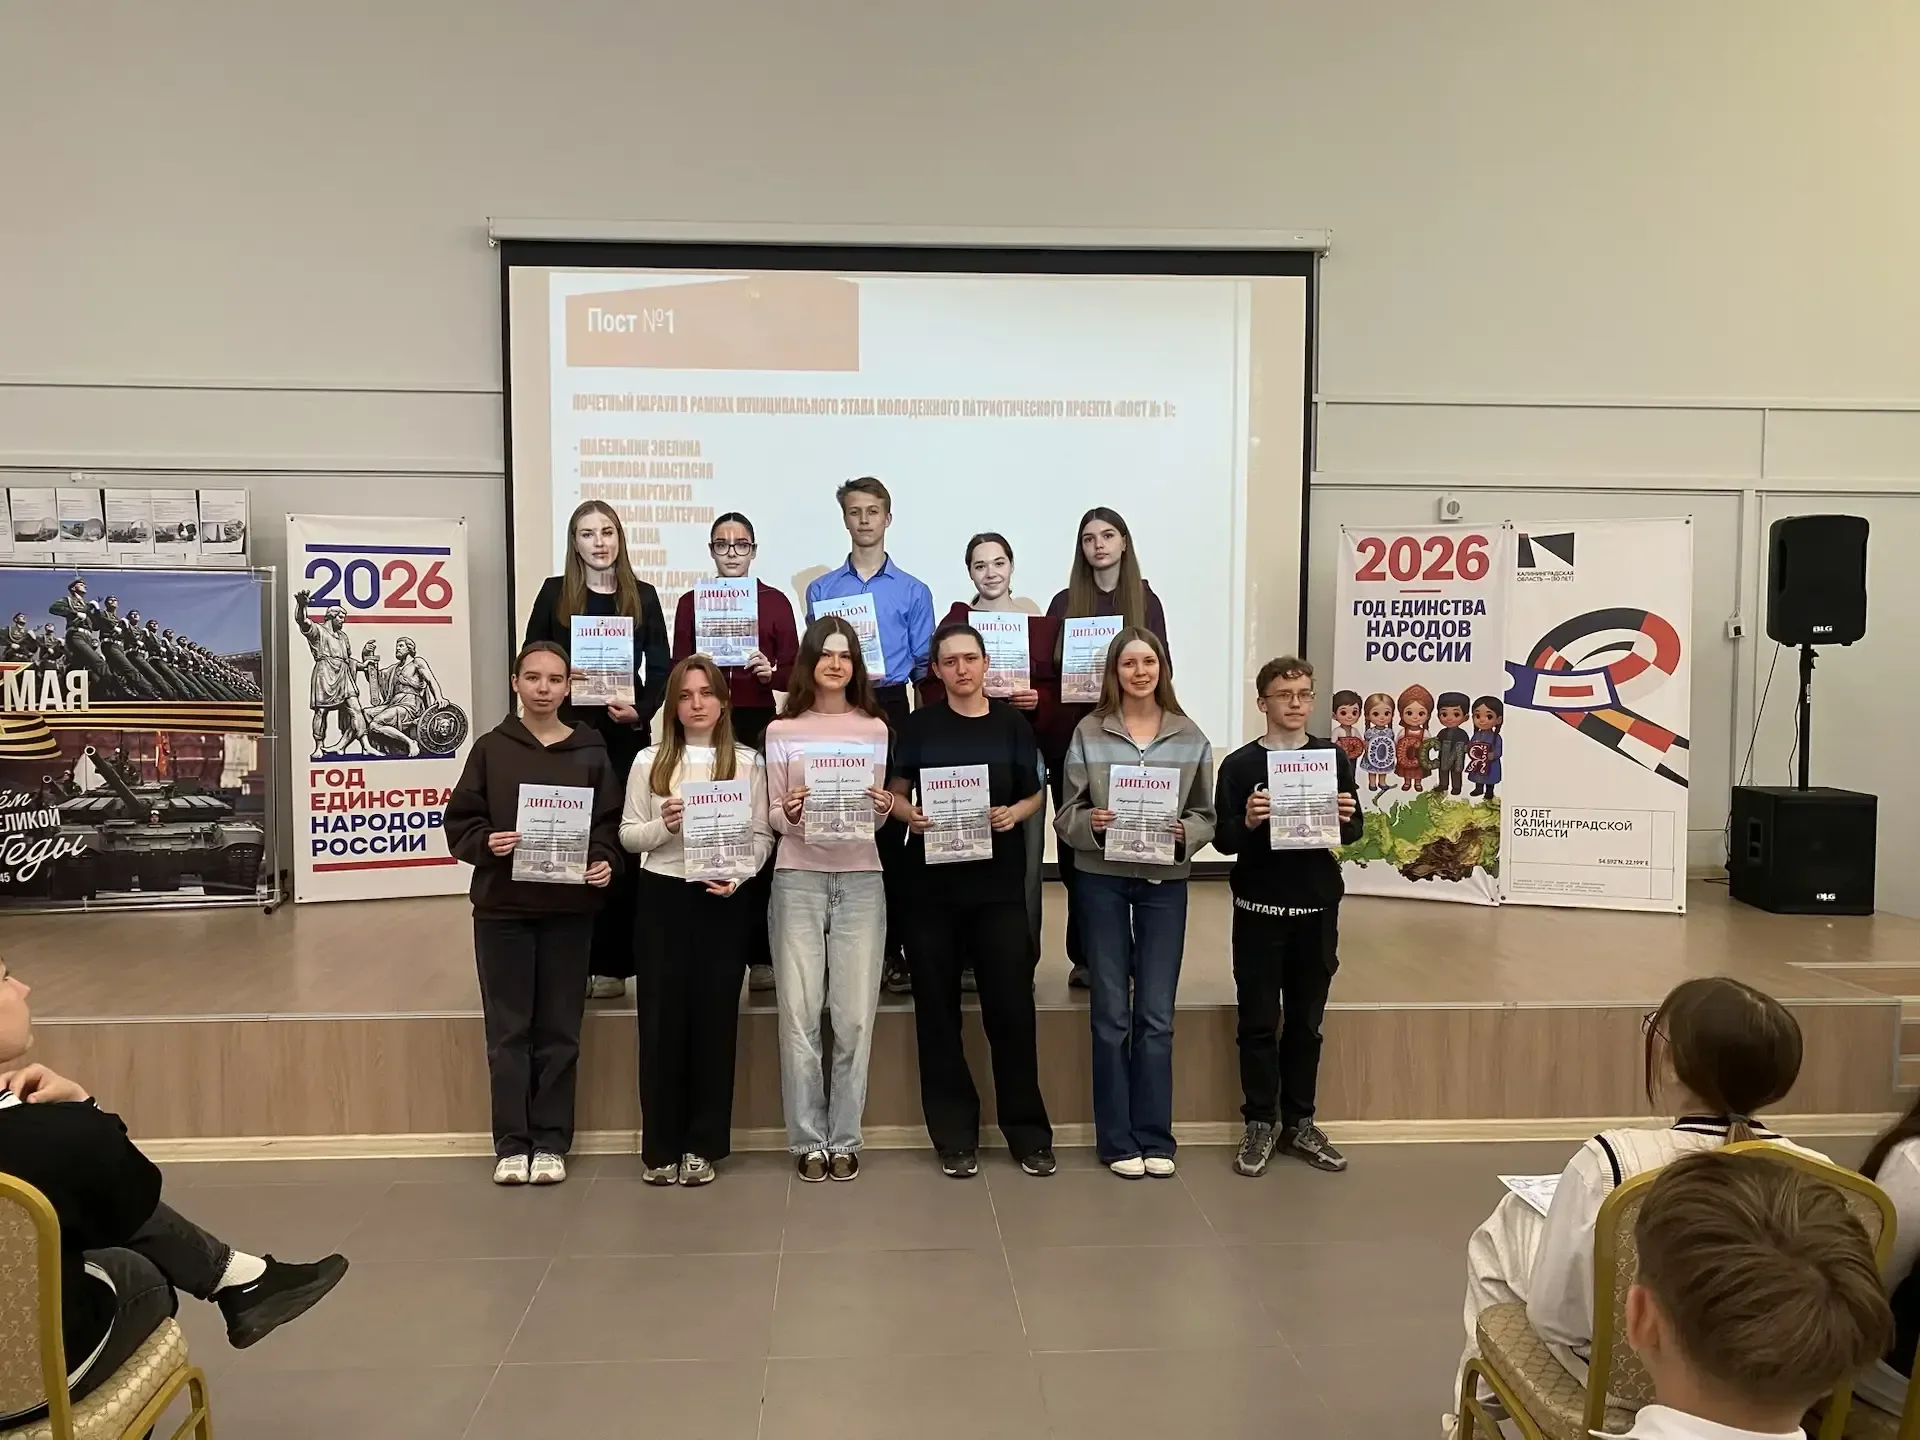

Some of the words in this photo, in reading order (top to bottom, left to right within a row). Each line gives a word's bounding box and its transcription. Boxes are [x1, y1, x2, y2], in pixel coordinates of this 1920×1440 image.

[588, 307, 638, 333] Пост
[643, 308, 674, 334] №1
[1355, 535, 1490, 581] 2026
[305, 558, 453, 609] 2026
[700, 589, 750, 599] ДИПЛОМ
[1353, 600, 1386, 618] ГОД
[1391, 599, 1486, 618] ЕДИНСТВА
[576, 628, 626, 637] ДИПЛОМ
[976, 623, 1021, 632] ДИПЛОМ
[1069, 627, 1115, 638] ДИПЛОМ
[1366, 620, 1471, 640] НАРОДОВ
[1366, 641, 1471, 662] РОССИИ
[3, 669, 89, 712] МАЯ
[811, 758, 865, 769] ДИПЛОМ
[1274, 762, 1328, 774] ДИПЛОМ
[310, 768, 365, 789] ГОД
[927, 778, 981, 791] ДИПЛОМ
[1115, 778, 1171, 790] ДИПЛОМ
[311, 788, 453, 813] ЕДИНСТВА
[524, 797, 584, 809] ДИПЛОМ
[687, 792, 743, 806] ДИПЛОМ
[1513, 809, 1528, 818] 80
[1530, 809, 1552, 819] ЛЕТ
[311, 811, 444, 834] НАРОДОВ
[1513, 818, 1633, 831] КАЛИНИНГРАДСКОЙ
[1513, 828, 1568, 838] ОБЛАСТИ
[312, 834, 426, 856] РОССИИ
[1235, 897, 1286, 917] MILITARY
